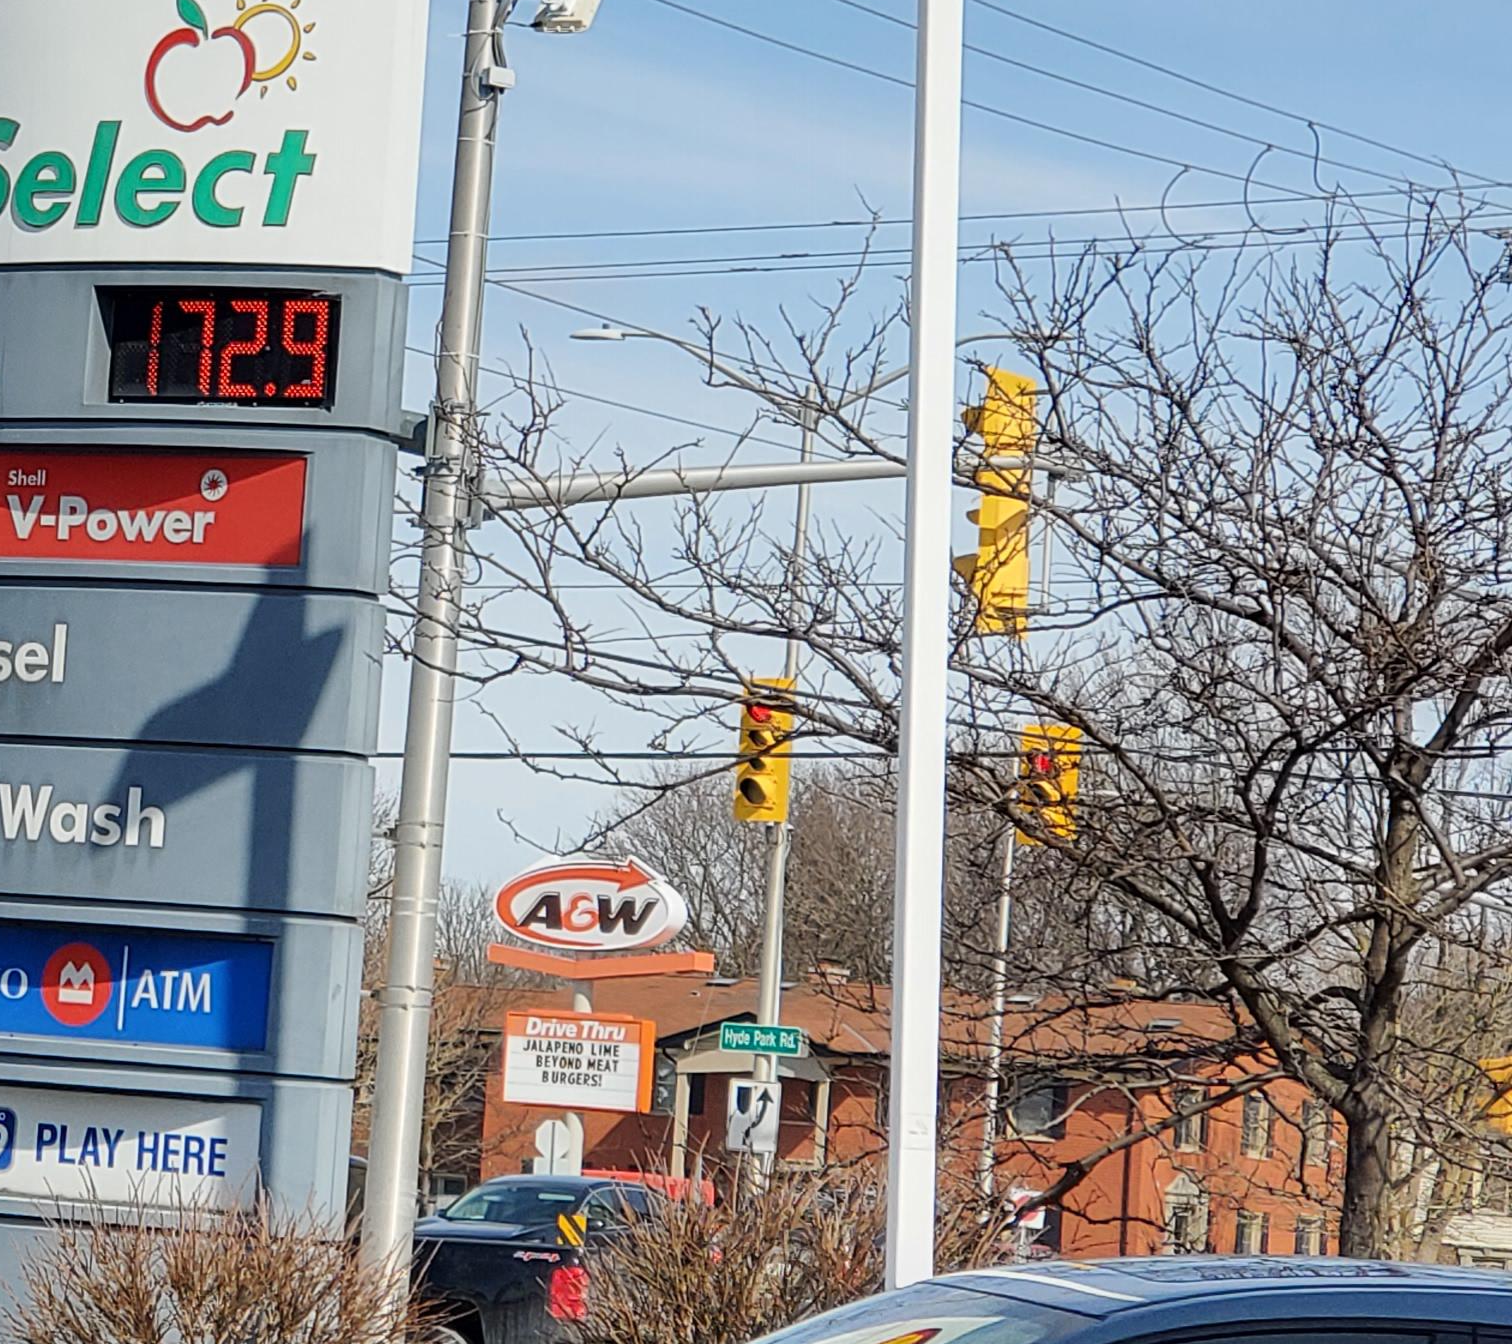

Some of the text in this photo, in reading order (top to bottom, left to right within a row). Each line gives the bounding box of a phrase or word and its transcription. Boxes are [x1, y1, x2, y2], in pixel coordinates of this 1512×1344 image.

[144, 299, 329, 398] 172.9
[6, 469, 47, 487] Shell
[5, 493, 216, 545] V-Power
[516, 891, 660, 937] A&W
[131, 969, 212, 1014] ATM
[525, 1016, 626, 1042] Drive Thru
[724, 1028, 750, 1048] Hyde
[753, 1030, 777, 1048] Park
[522, 1040, 621, 1057] JALAPENO LIME
[535, 1055, 619, 1073] BEYOND MEAT
[542, 1071, 602, 1087] BURGERS!
[35, 1122, 228, 1178] PLAY HERE
